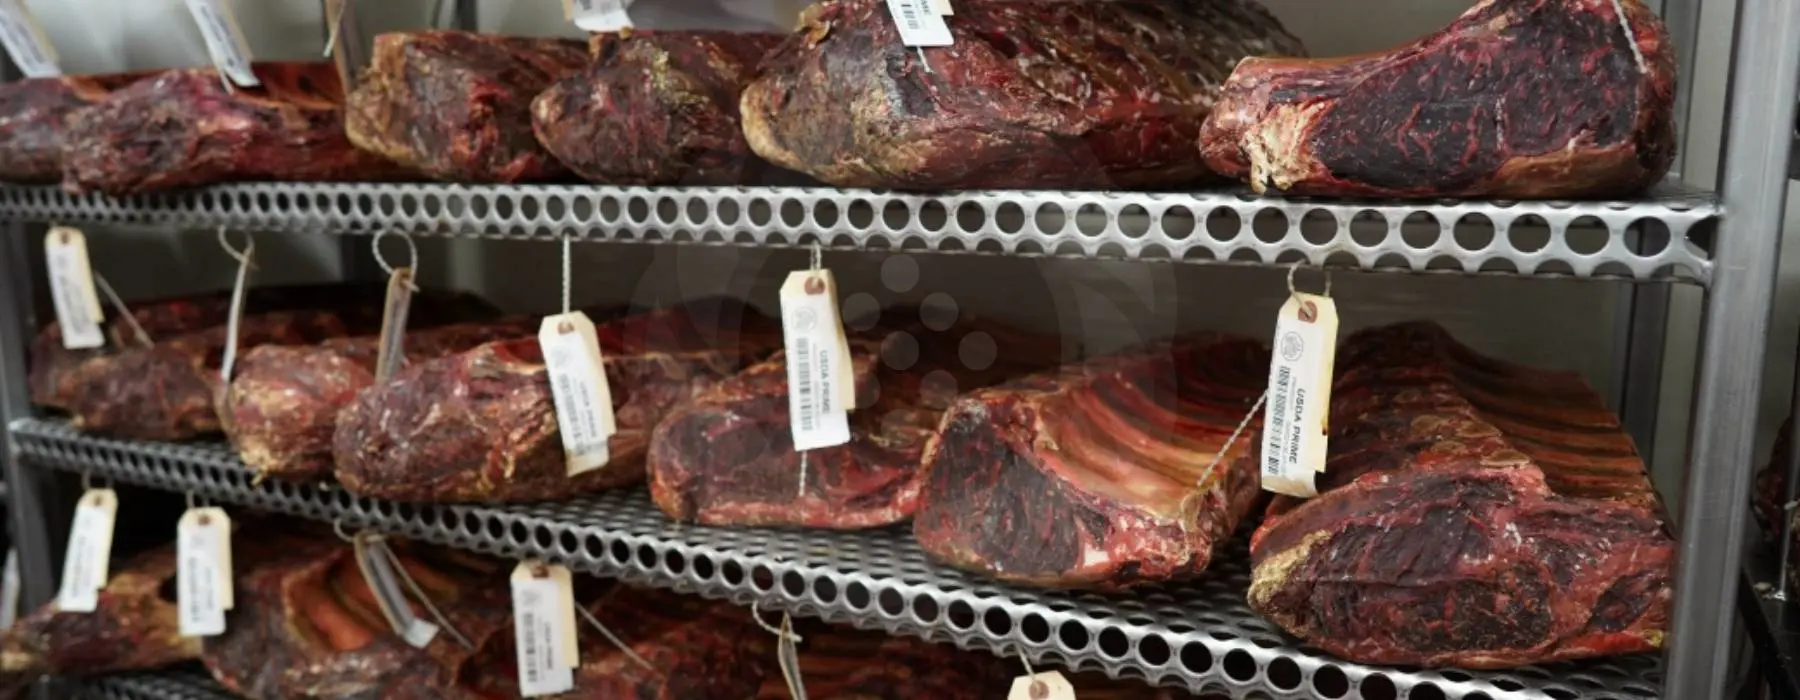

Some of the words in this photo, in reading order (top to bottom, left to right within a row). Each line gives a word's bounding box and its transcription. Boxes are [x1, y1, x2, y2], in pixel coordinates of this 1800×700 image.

[820, 349, 829, 379] USDA
[822, 382, 830, 413] PRIME
[1295, 388, 1306, 422] USDA
[1289, 425, 1301, 464] PRIME
